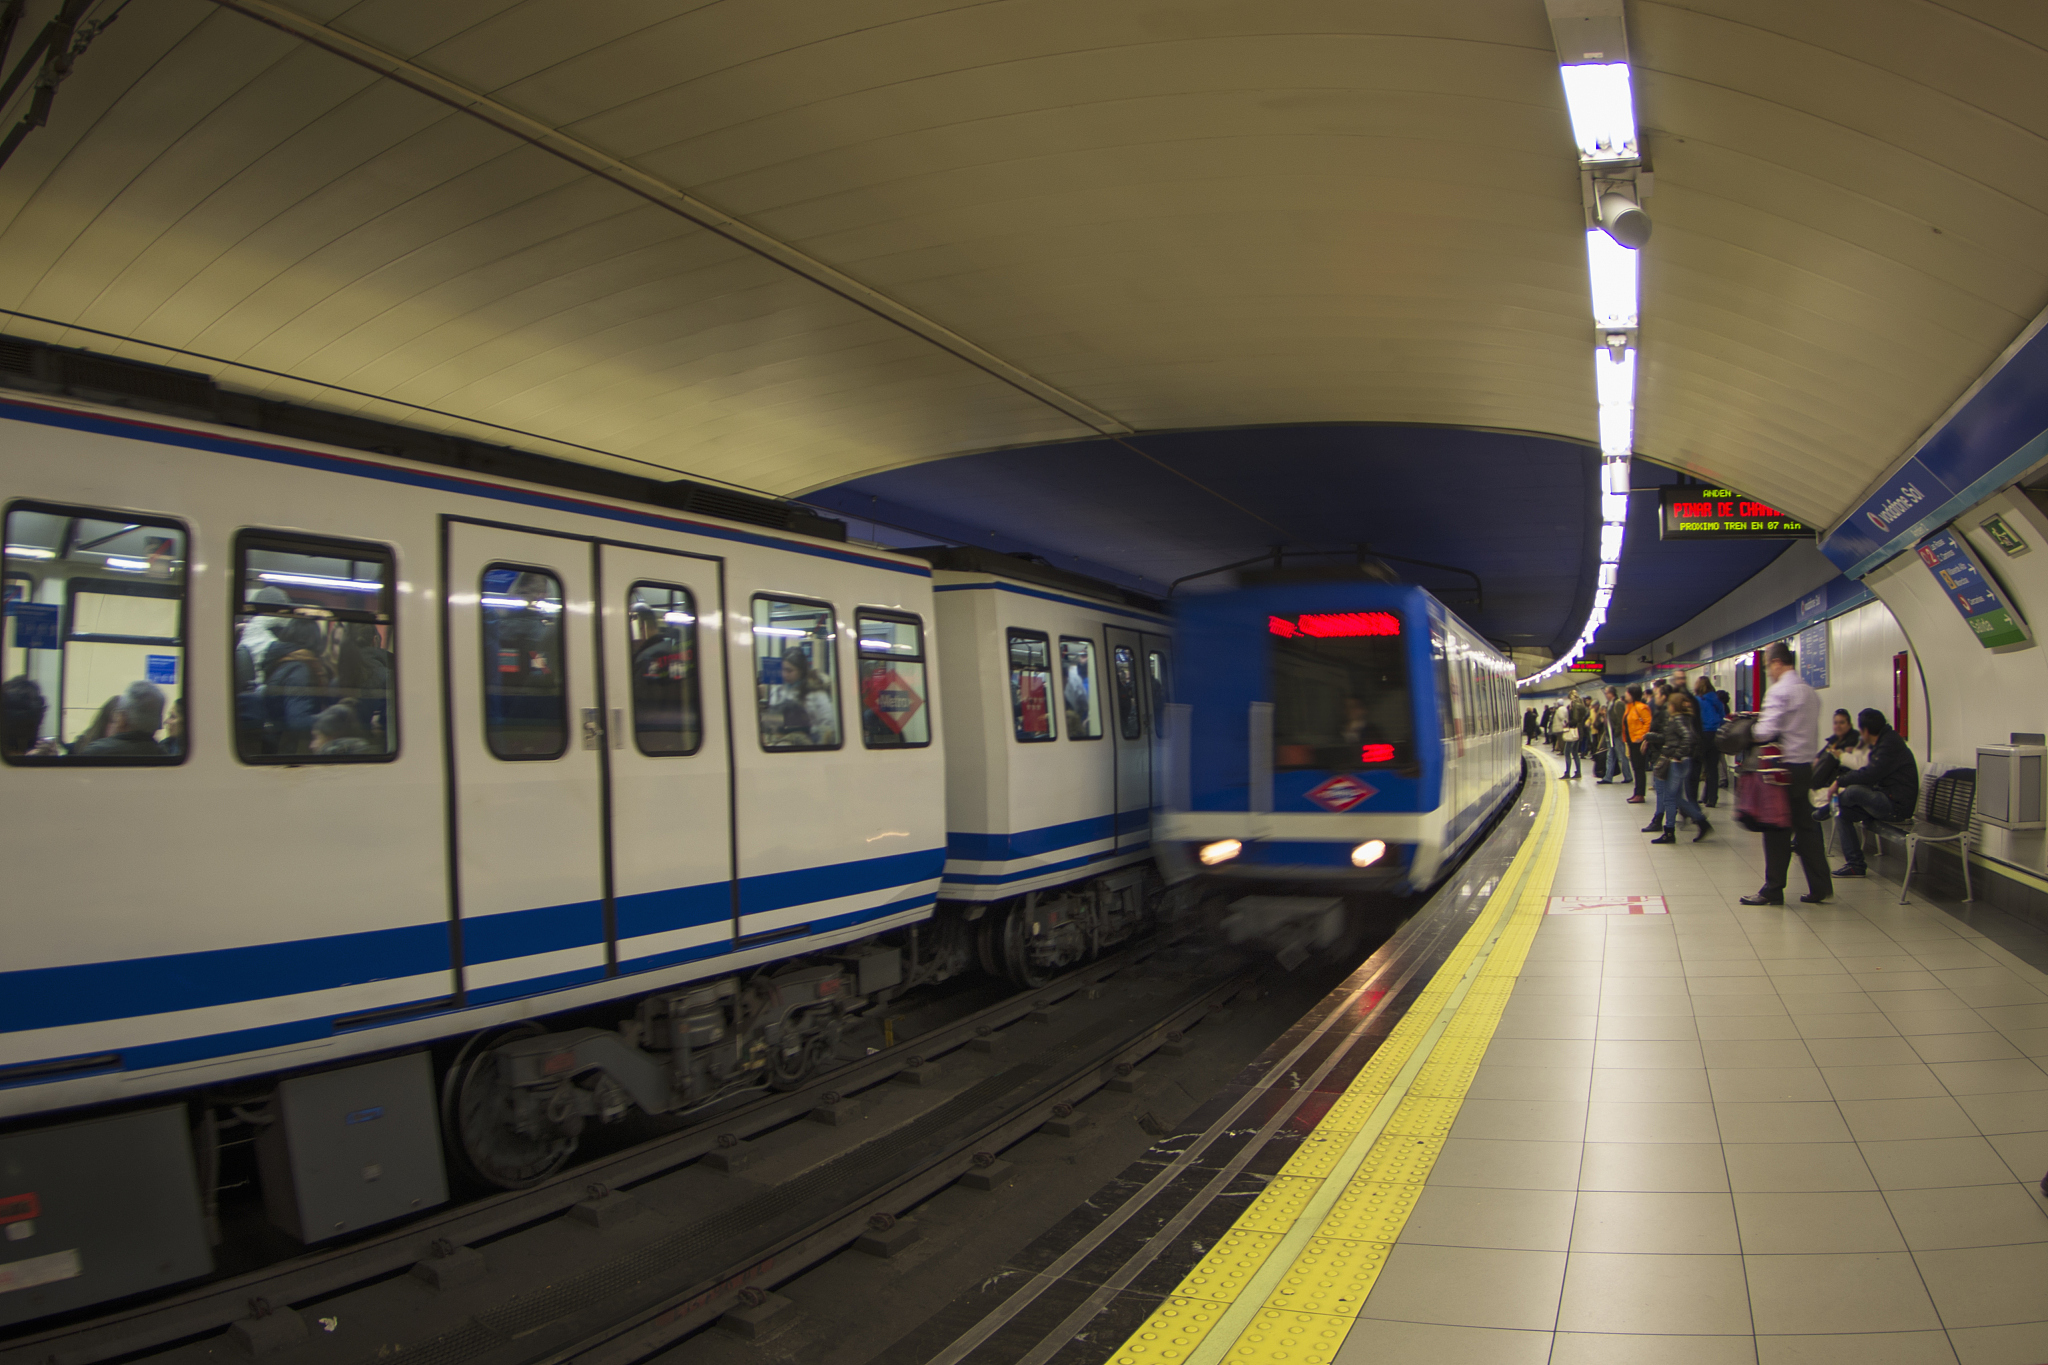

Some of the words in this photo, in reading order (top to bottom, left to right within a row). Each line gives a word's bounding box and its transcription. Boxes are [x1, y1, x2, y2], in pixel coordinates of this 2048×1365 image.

[1703, 489, 1731, 498] ANDEN
[1900, 482, 1925, 503] Sol
[1673, 502, 1712, 518] PINAR
[1718, 502, 1734, 517] DE
[1680, 522, 1720, 531] PROXIMO
[1724, 521, 1747, 530] TREN
[1751, 521, 1763, 530] EN
[1767, 521, 1779, 530] 07
[1784, 521, 1801, 530] min
